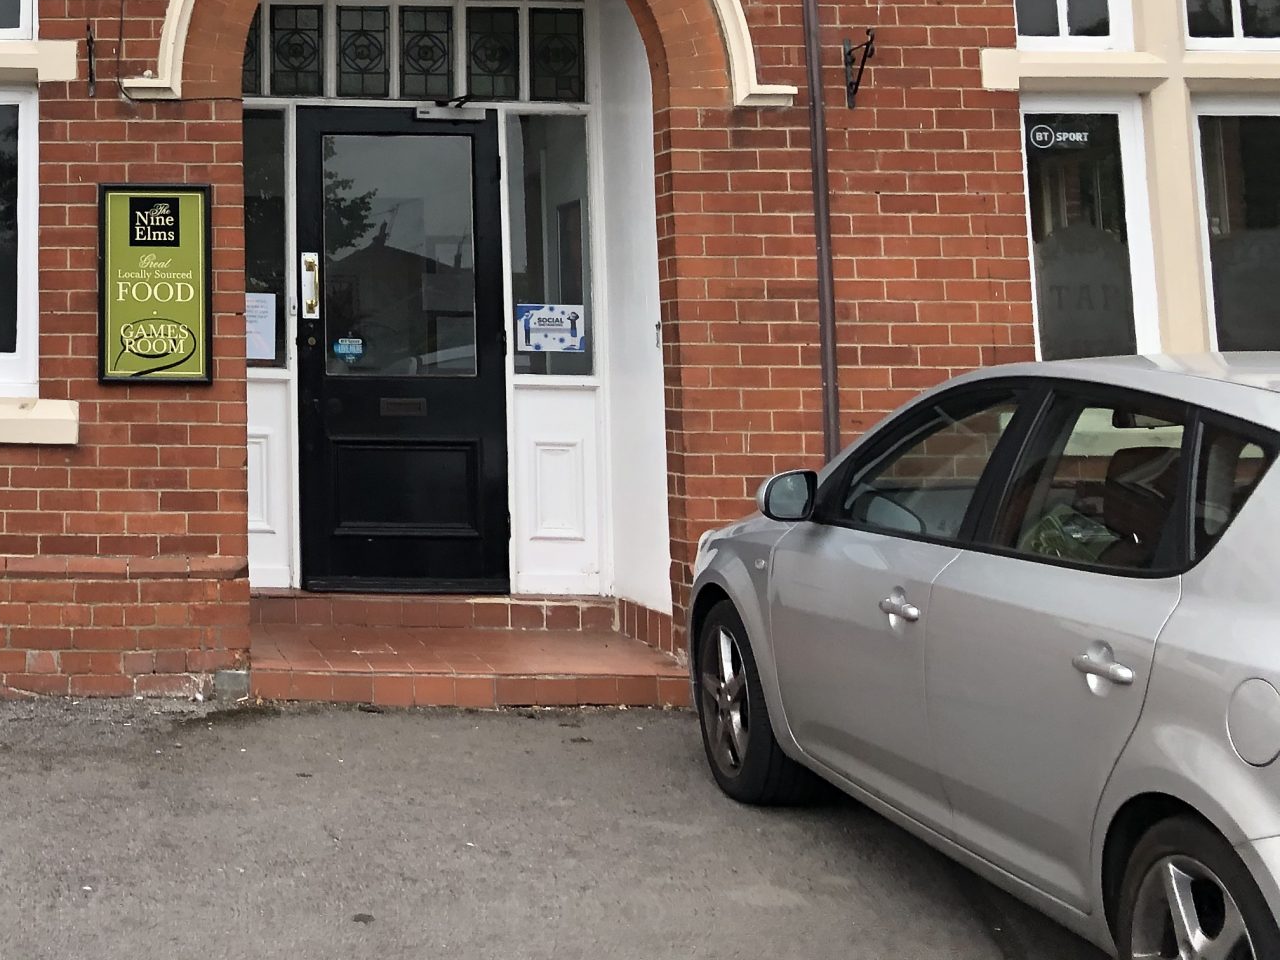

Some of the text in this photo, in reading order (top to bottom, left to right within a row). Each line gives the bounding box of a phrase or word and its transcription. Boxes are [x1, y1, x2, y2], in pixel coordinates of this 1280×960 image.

[1056, 132, 1089, 142] SPORT
[149, 203, 171, 217] The
[135, 211, 174, 226] Nine
[134, 226, 175, 241] Elms
[138, 253, 172, 269] Great
[118, 269, 193, 281] Locally Sourced
[116, 281, 195, 303] FOOD
[120, 323, 189, 340] GAMES
[124, 338, 186, 354] ROOM
